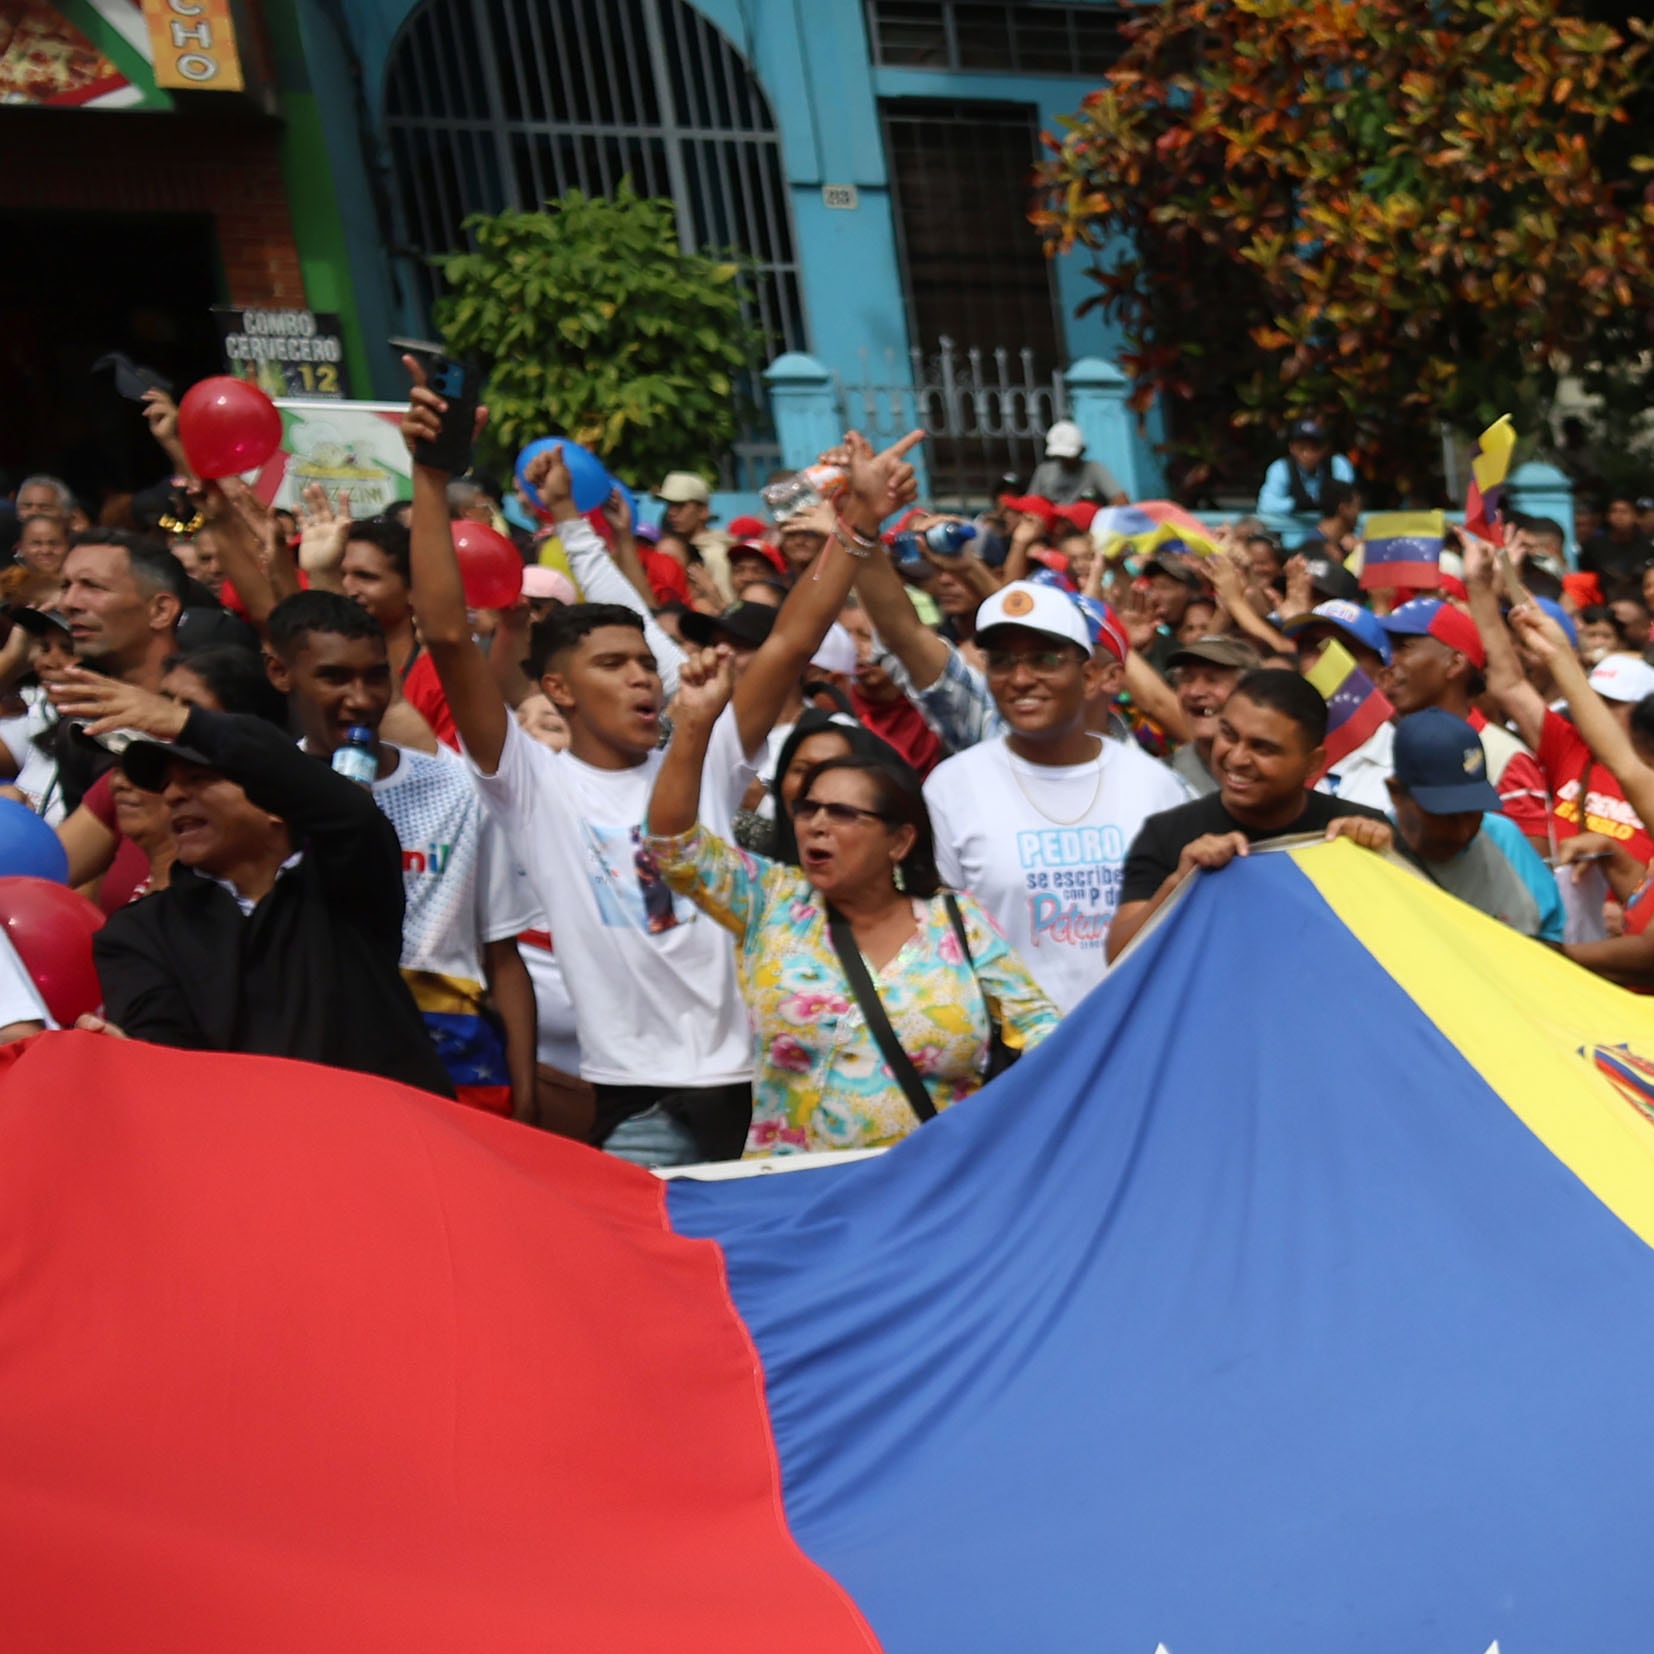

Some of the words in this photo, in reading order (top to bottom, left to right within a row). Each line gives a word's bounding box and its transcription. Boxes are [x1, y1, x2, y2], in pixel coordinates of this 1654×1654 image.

[243, 311, 315, 336] COMBO
[225, 335, 342, 362] CERVECERO
[298, 365, 339, 392] 12
[1017, 826, 1124, 868] PEDRO
[1027, 872, 1049, 889] se
[1053, 866, 1124, 888] escribe
[1063, 889, 1085, 900] con
[1090, 888, 1100, 907] P
[1028, 892, 1113, 947] Petar
